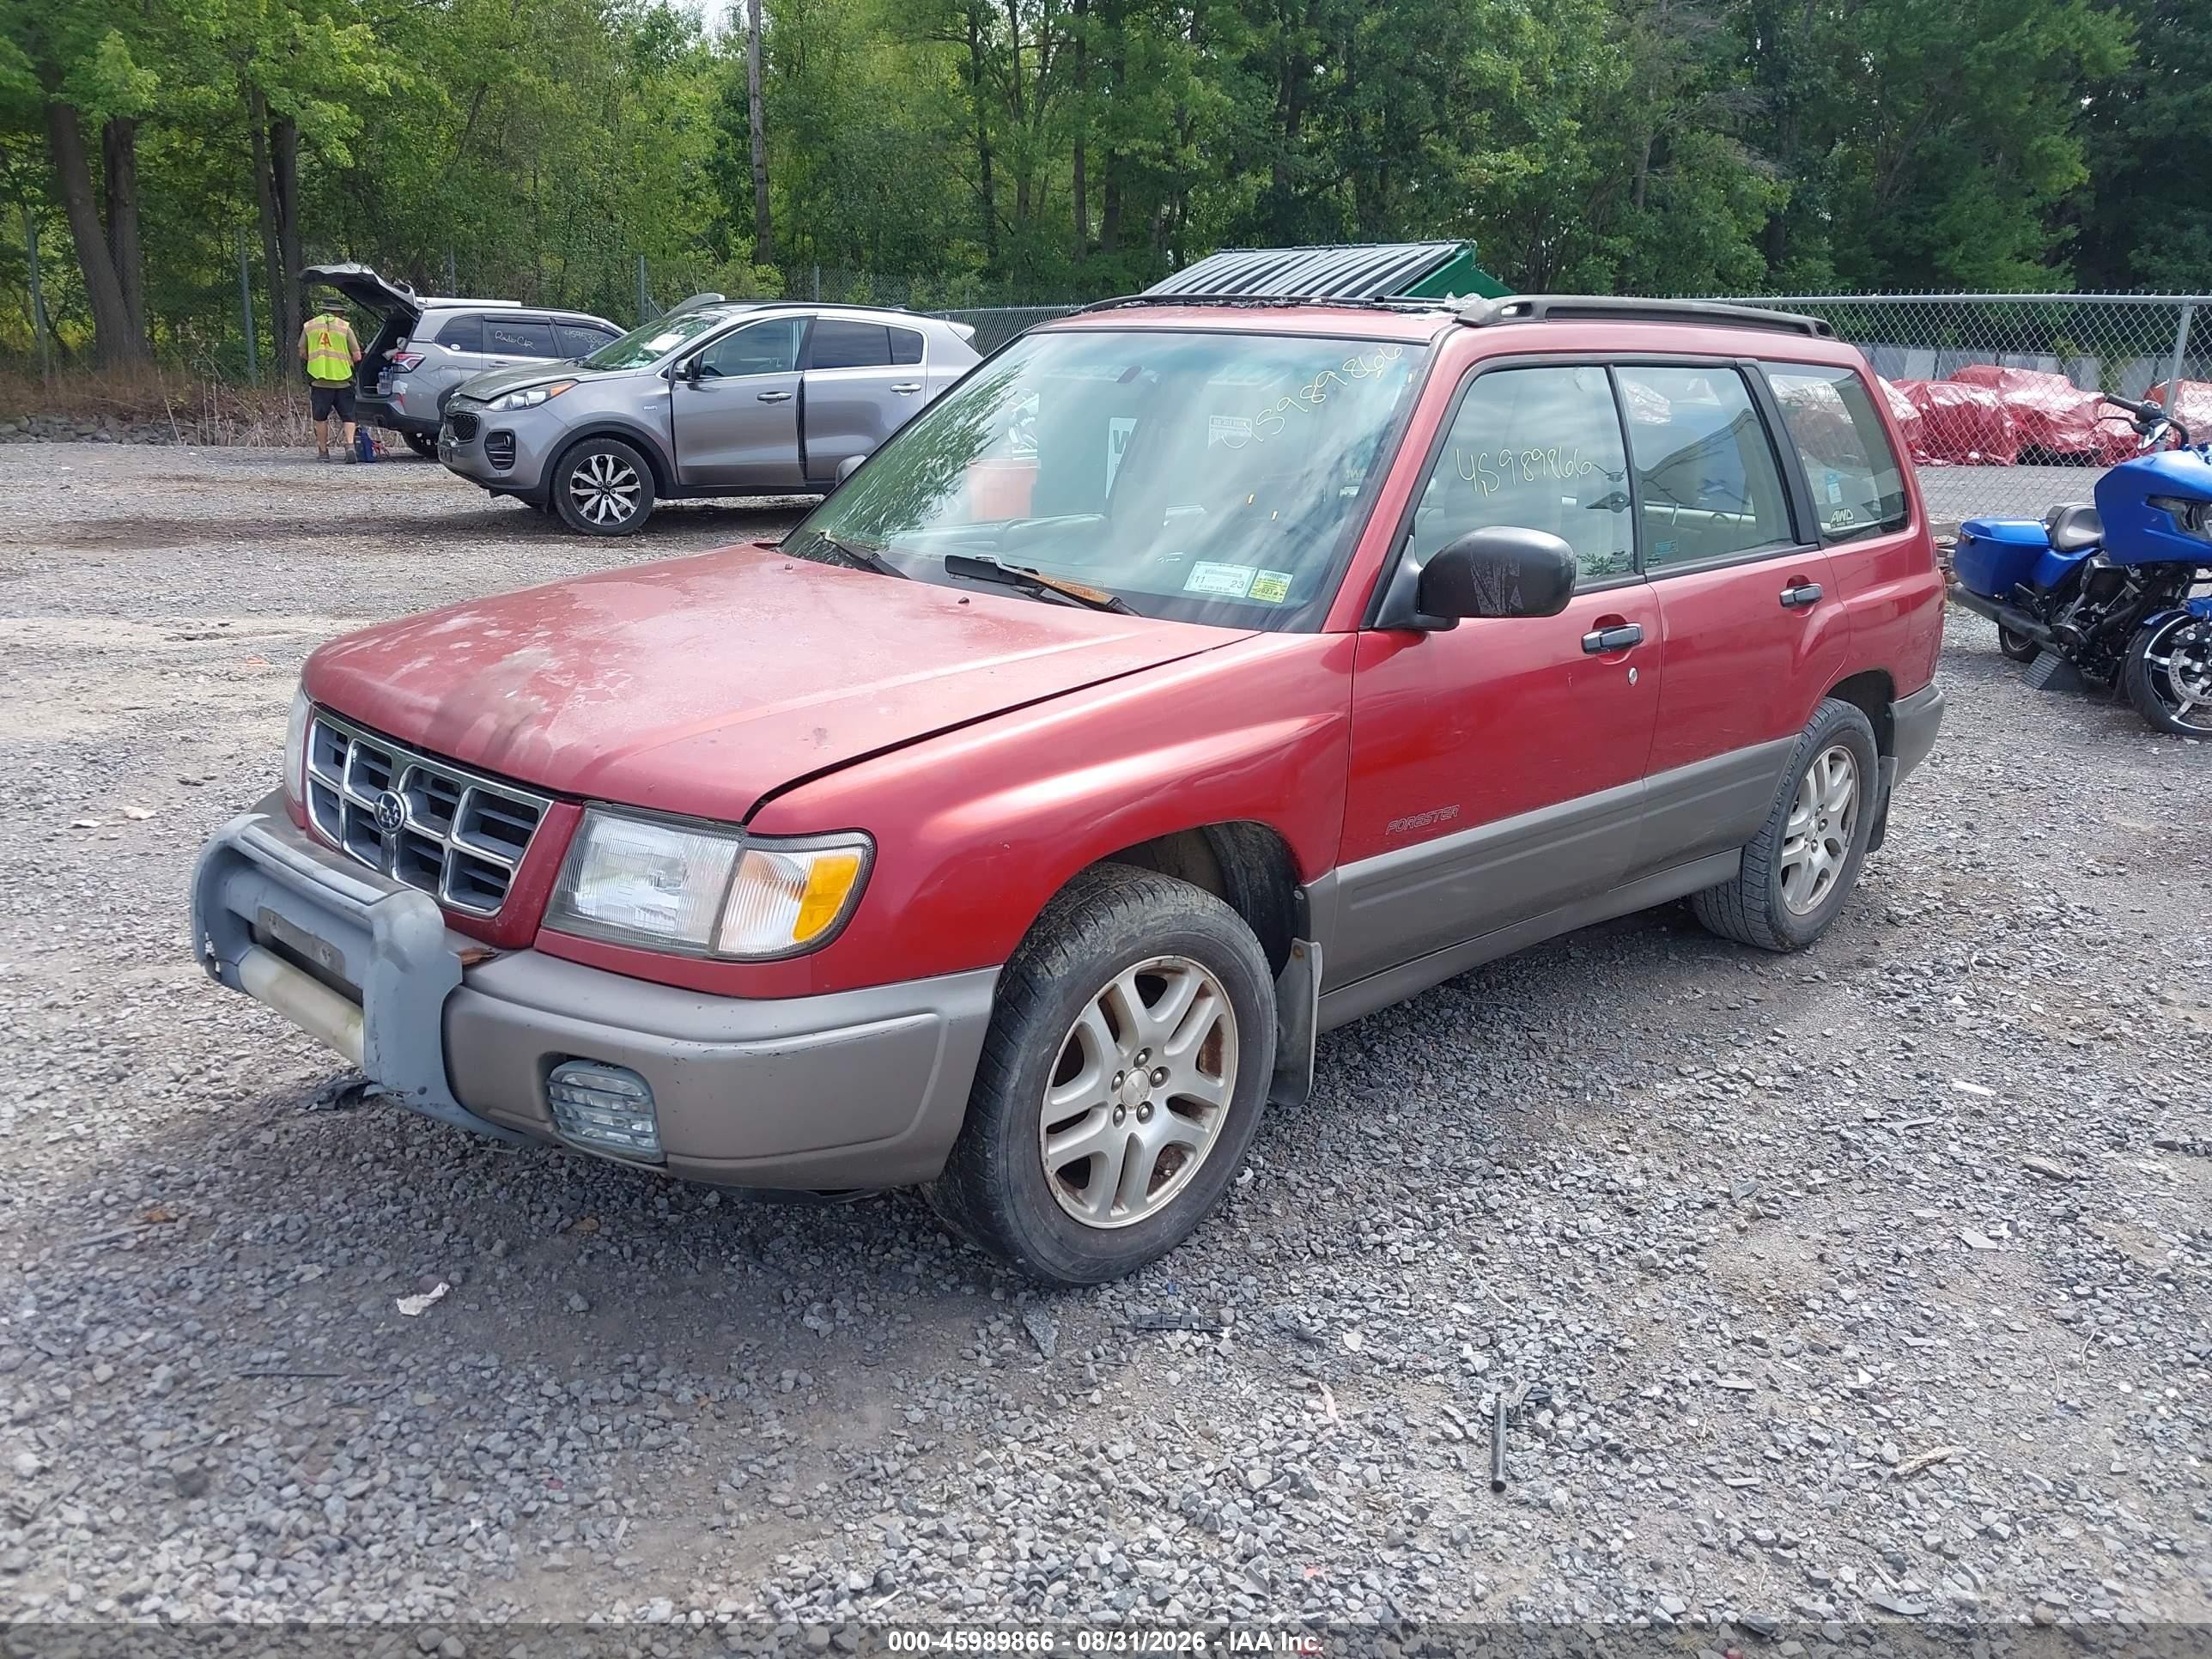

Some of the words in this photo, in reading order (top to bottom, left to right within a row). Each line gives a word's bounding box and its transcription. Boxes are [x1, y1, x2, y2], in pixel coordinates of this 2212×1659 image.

[1221, 347, 1402, 449] 45989866
[1455, 446, 1593, 495] 45989866
[1830, 508, 1854, 523] AWD
[1194, 575, 1206, 584] 11
[1229, 580, 1244, 589] 23
[1385, 804, 1461, 836] FORESTER
